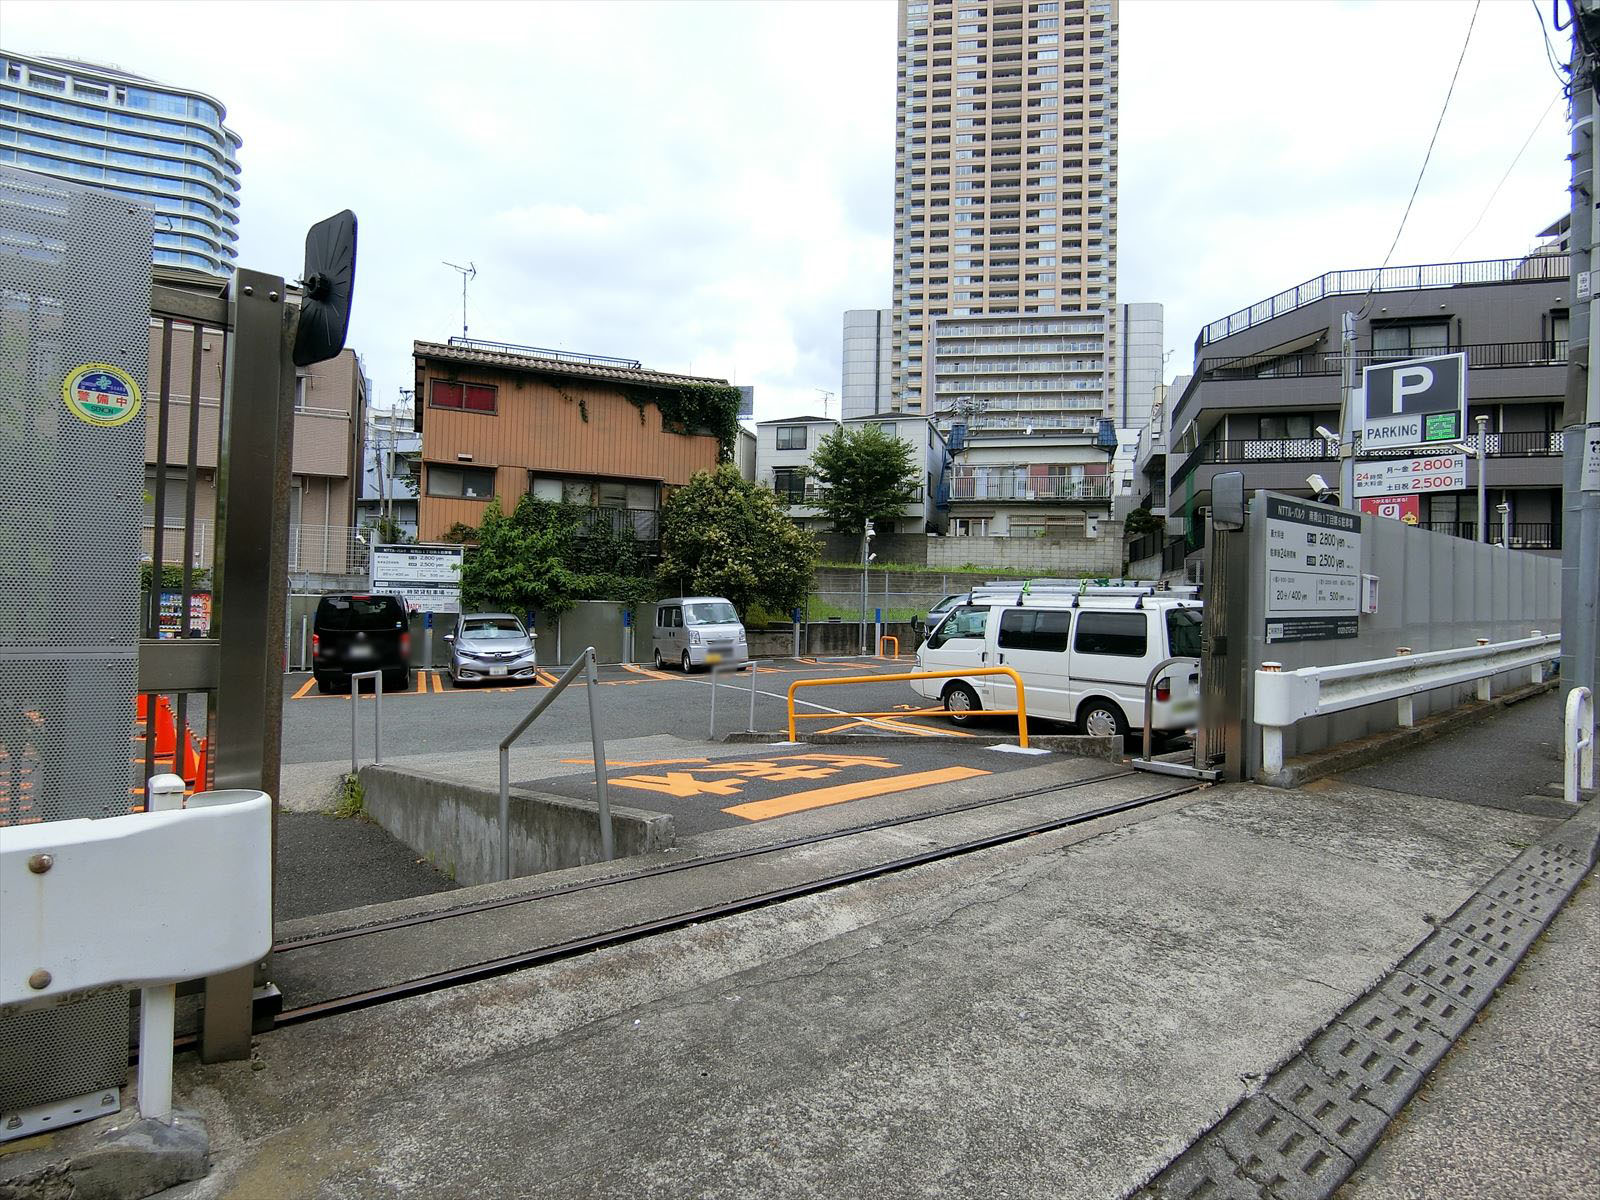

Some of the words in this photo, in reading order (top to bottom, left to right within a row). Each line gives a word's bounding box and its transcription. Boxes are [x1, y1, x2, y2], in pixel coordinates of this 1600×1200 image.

[1392, 366, 1434, 414] P
[1367, 424, 1418, 440] PARKING
[1356, 473, 1383, 481] 24時間
[1386, 482, 1409, 491] 土日祝
[1336, 538, 1345, 551] yen
[1335, 559, 1344, 571] yen
[592, 754, 902, 797] 止まれ
